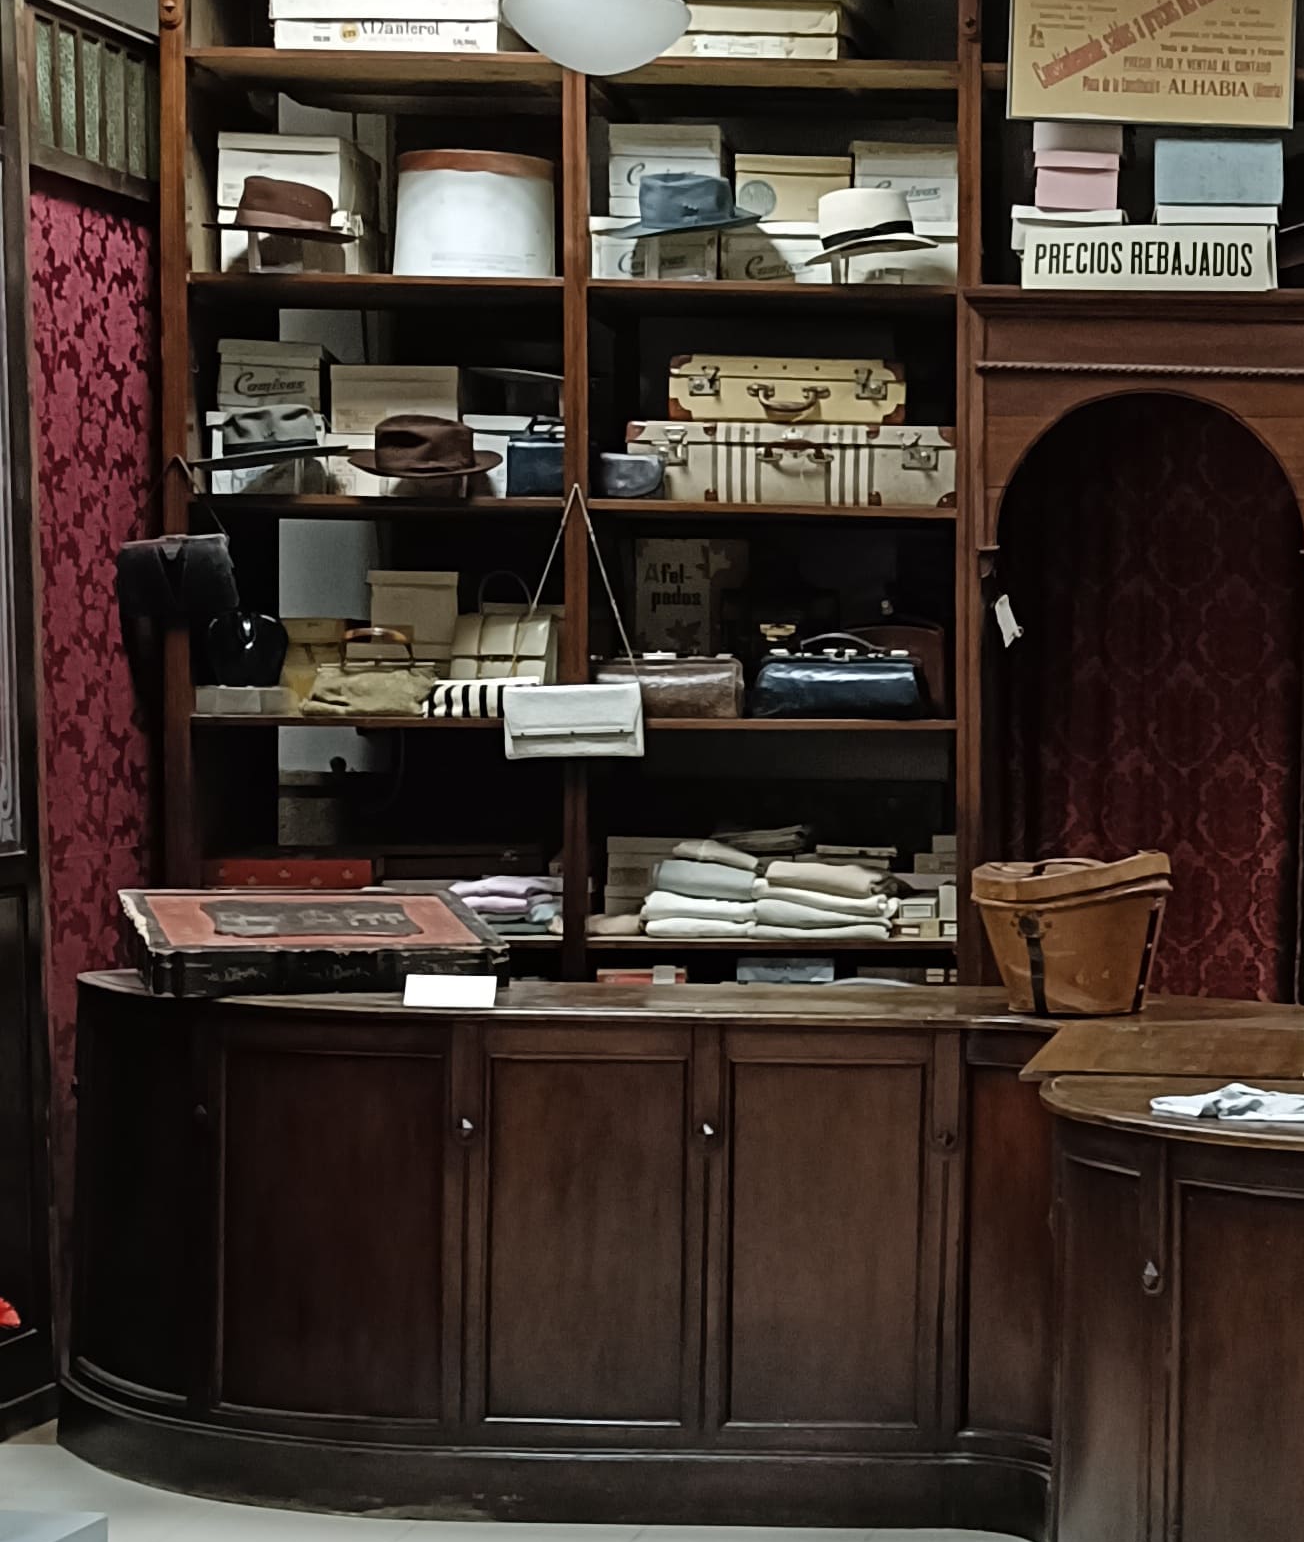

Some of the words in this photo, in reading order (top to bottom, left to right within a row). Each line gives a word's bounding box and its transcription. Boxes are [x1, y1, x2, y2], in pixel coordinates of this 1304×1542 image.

[1187, 59, 1217, 72] VENTAS
[1168, 78, 1249, 97] ALHABIA
[1034, 241, 1122, 275] PRECIOS
[1131, 241, 1253, 277] REBAJADOS
[234, 371, 306, 398] Camisas
